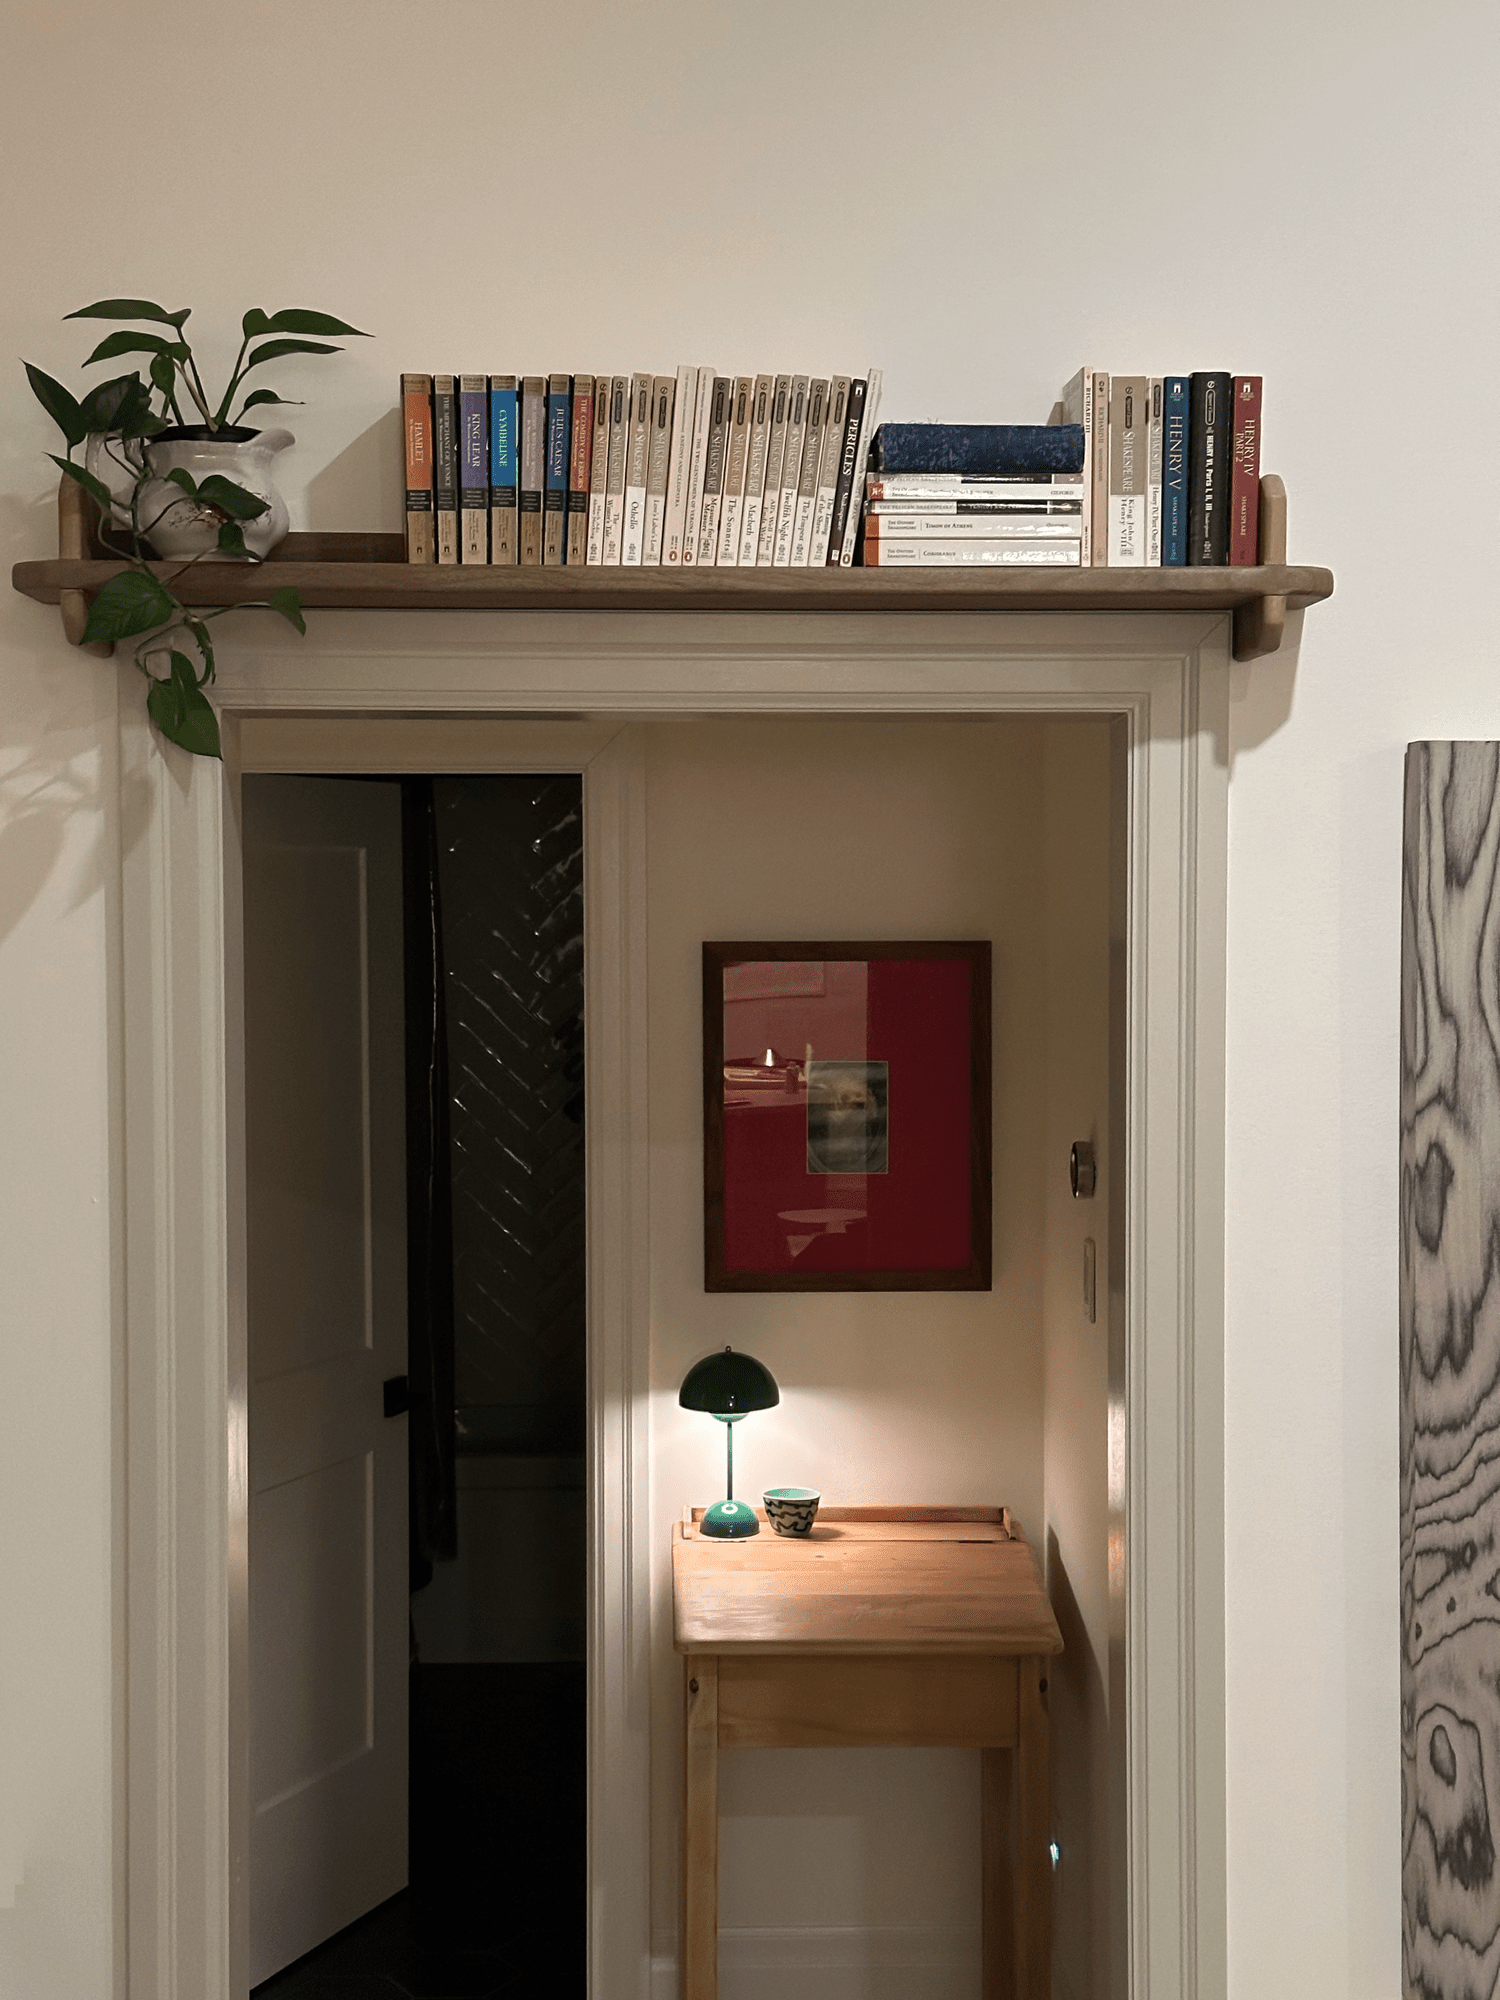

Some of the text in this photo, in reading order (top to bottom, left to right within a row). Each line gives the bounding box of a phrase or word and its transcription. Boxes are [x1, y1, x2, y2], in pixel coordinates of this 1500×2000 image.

[415, 422, 423, 462] HAMLET
[444, 450, 450, 461] OF
[472, 413, 480, 466] KING LEAR
[499, 410, 507, 466] CYMBELINE
[554, 408, 564, 476] JULIUS CAESAR
[578, 448, 585, 459] OF
[593, 436, 606, 489] SHAKESPEARE
[610, 434, 623, 488] SHAKESPEARE
[632, 433, 645, 485] SHAKESPEARE
[651, 431, 666, 490] SHAKESPEARE
[707, 435, 722, 490] SHAKESPEARE
[730, 433, 745, 488] SHAKESPEARE
[748, 434, 765, 493] SHAKESPEARE
[768, 430, 782, 483] SHAKESPEARE
[785, 435, 800, 487] SHAKESPEARE
[802, 436, 818, 490] SHAKESPEARE
[823, 434, 838, 486] SHAKESPEARE
[843, 418, 858, 475] PERICLES
[1122, 431, 1135, 491] SHAKESPEARE
[1150, 425, 1161, 480] SHAKESPEARE
[1168, 416, 1182, 490] HENRY V
[1205, 458, 1213, 468] VI,
[1235, 432, 1244, 455] PART
[1243, 419, 1255, 476] HENRY IV
[819, 494, 825, 503] of
[1150, 487, 1158, 504] Henry
[1204, 494, 1213, 502] II,
[1205, 468, 1213, 486] Parts
[630, 501, 639, 529] Othello
[691, 500, 696, 508] OF
[708, 497, 717, 526] Measure
[724, 498, 736, 550] The Sonnets
[746, 504, 756, 535] Macbeth
[778, 490, 793, 541] Twelfth Night
[798, 500, 810, 541] The Tempest
[815, 515, 823, 534] Shrew
[821, 513, 831, 535] Taming
[837, 492, 848, 531] Shakespeare
[1118, 499, 1126, 525] Henry
[1126, 498, 1134, 518] King
